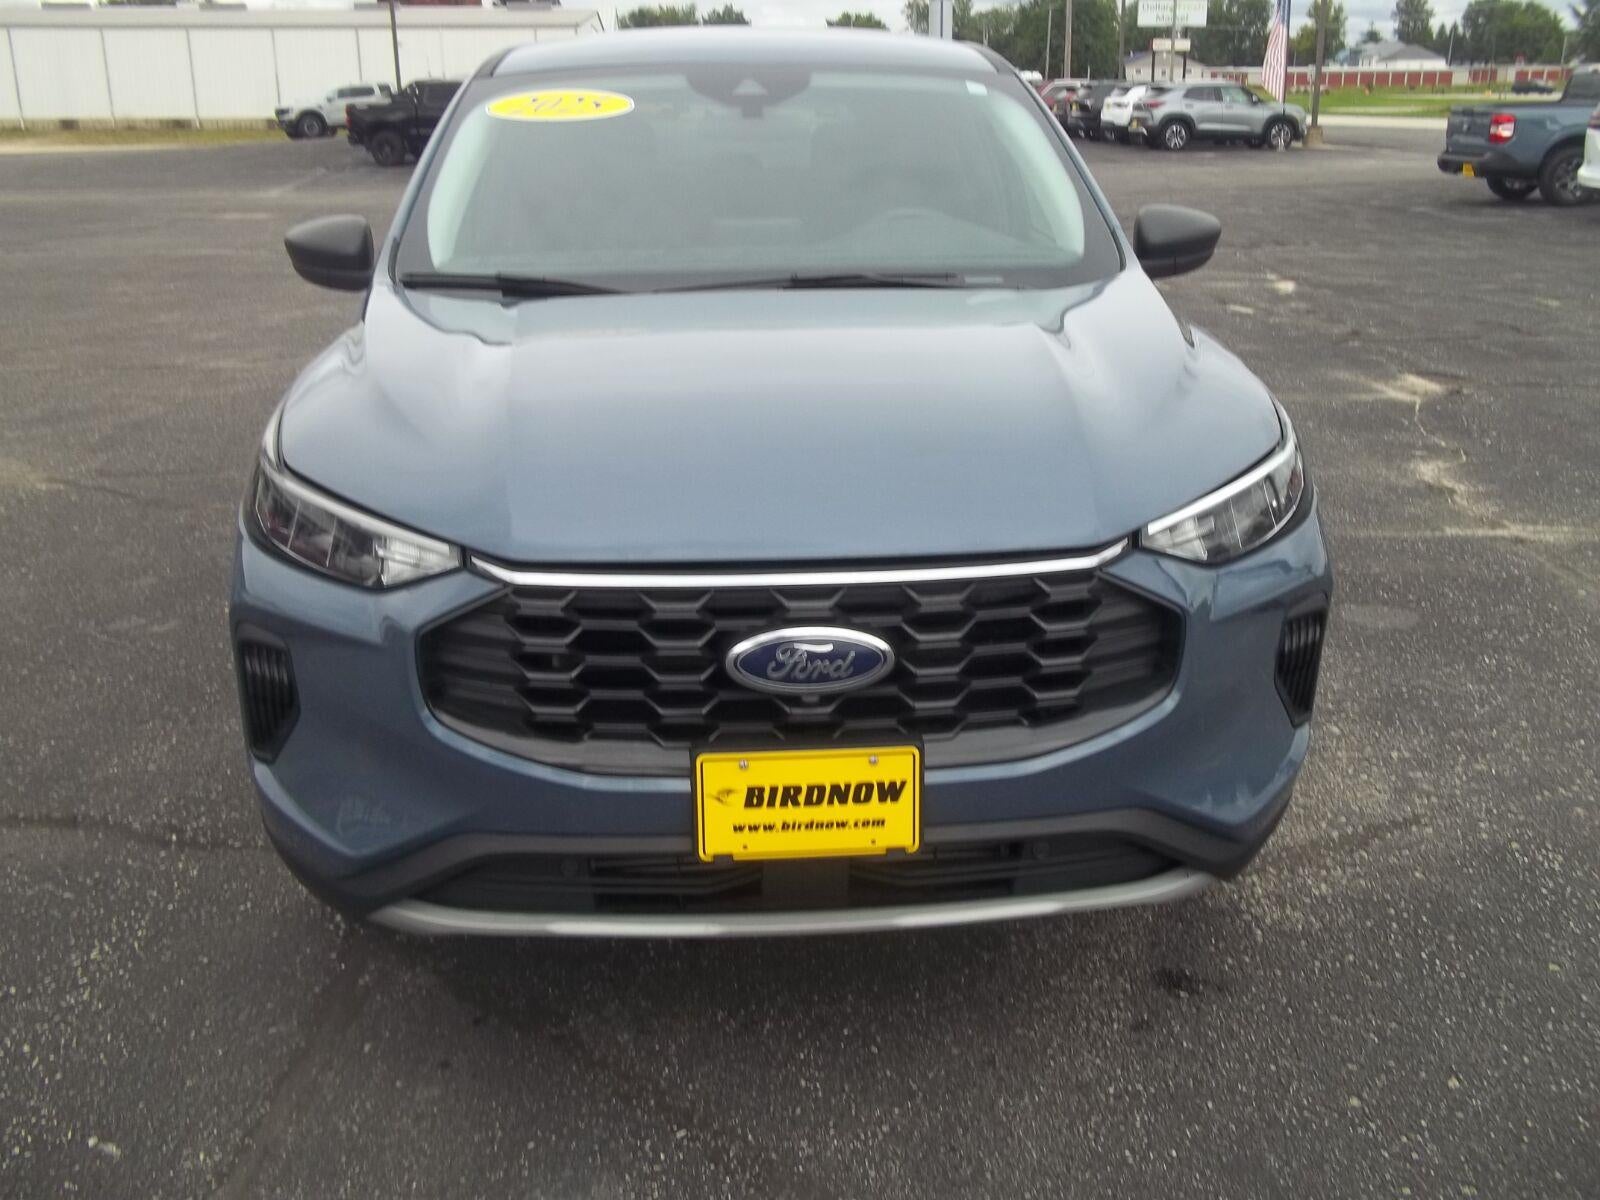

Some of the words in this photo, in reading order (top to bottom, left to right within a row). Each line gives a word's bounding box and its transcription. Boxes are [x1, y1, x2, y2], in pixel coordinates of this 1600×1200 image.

[766, 642, 855, 679] Ford
[743, 780, 907, 809] BIRDNOW
[732, 817, 886, 833] www.birdnow.com
